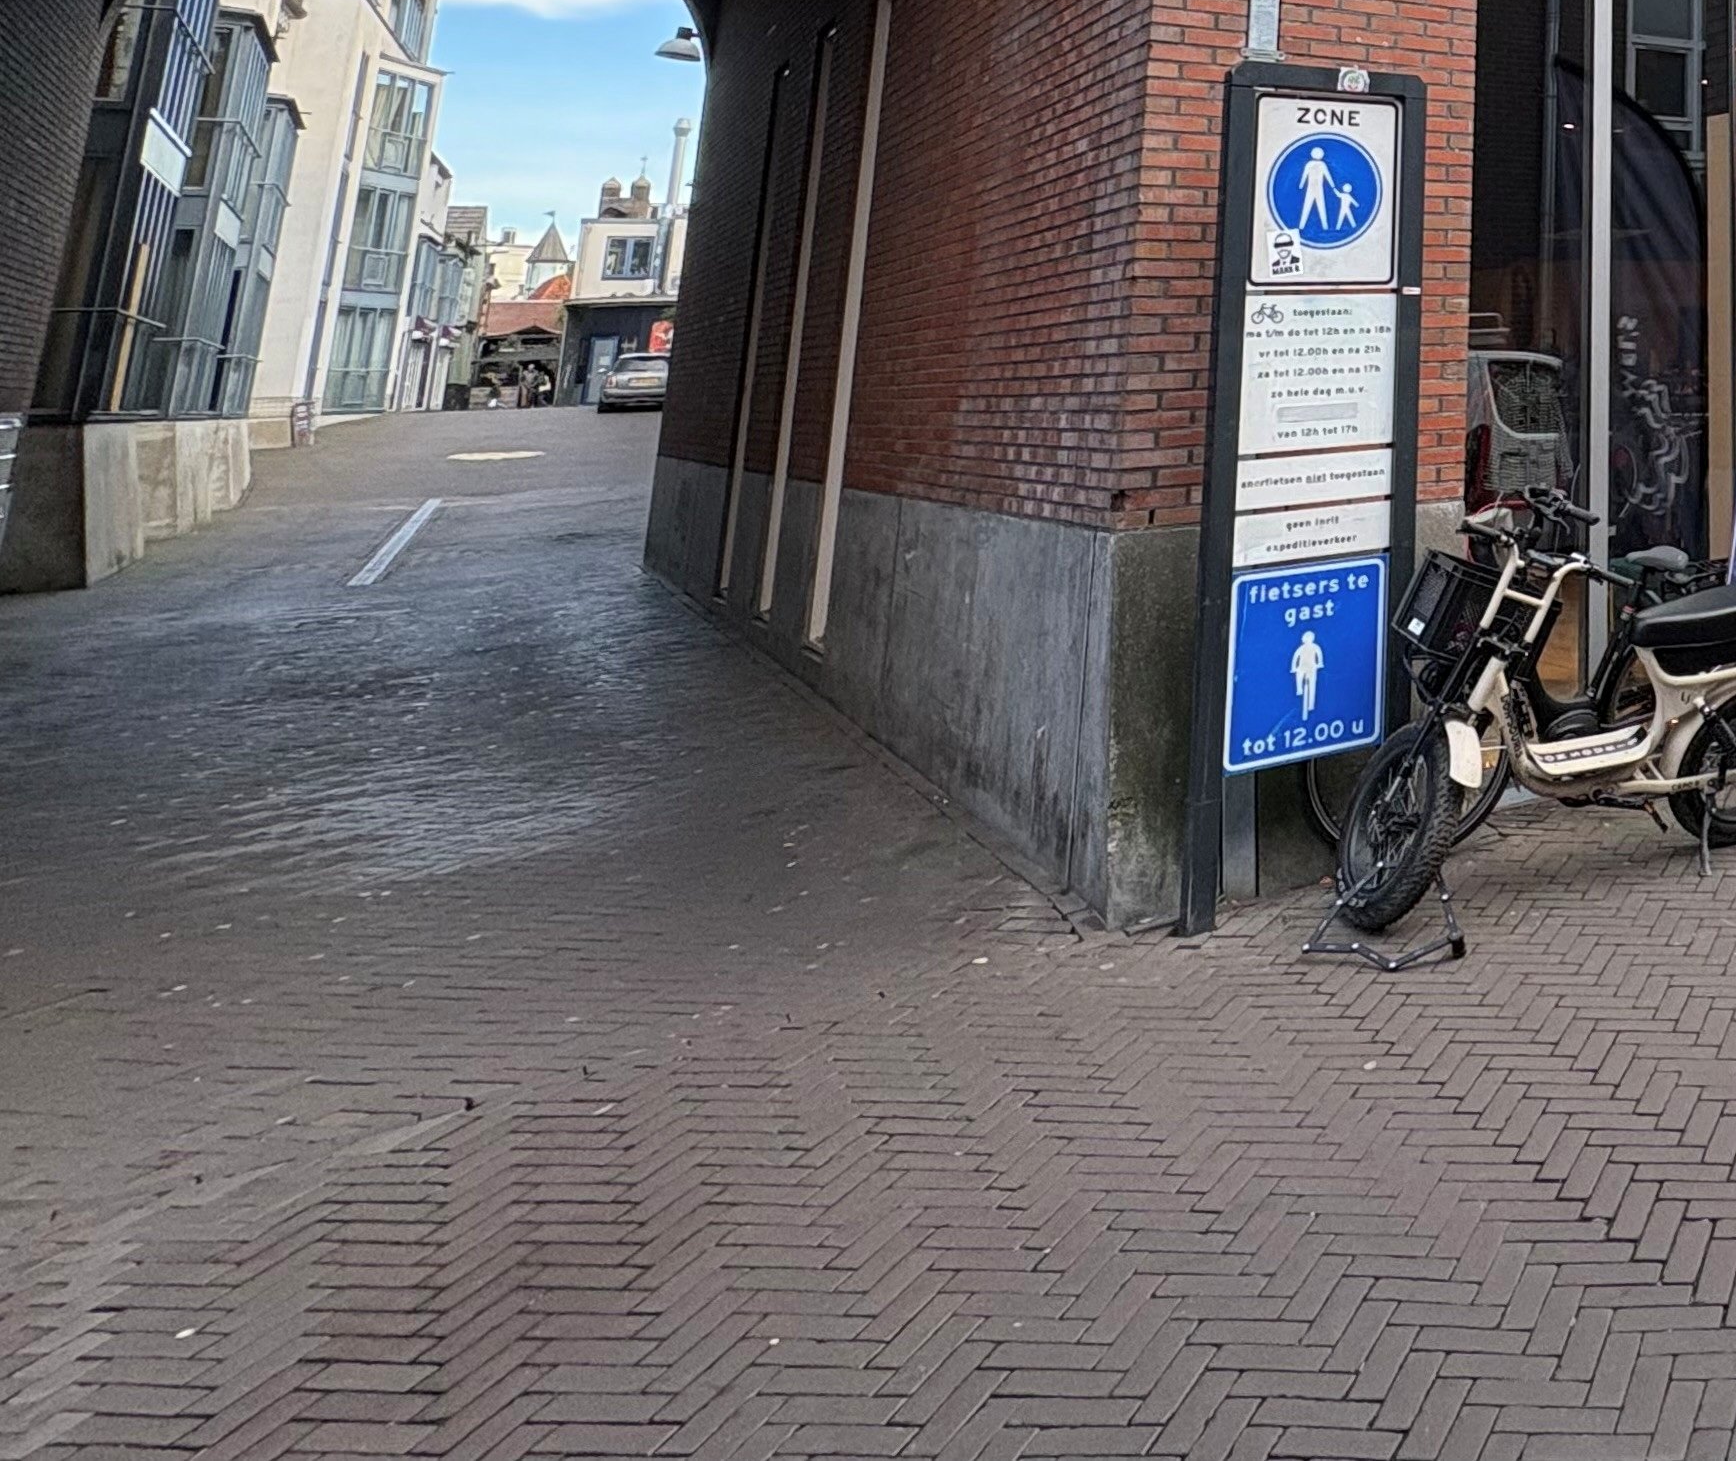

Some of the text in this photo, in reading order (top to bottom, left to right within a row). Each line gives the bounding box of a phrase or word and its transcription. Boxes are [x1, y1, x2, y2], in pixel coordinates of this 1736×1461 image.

[1296, 107, 1360, 126] ZONE
[1265, 329, 1284, 338] t/m
[1288, 328, 1300, 337] do
[1303, 328, 1319, 336] tot
[1322, 327, 1340, 336] 12h
[1274, 349, 1289, 357] tot
[1332, 347, 1344, 355] en
[1274, 369, 1289, 378] tot
[1332, 367, 1345, 375] en
[1313, 387, 1332, 397] dag
[1277, 430, 1298, 439] van
[1323, 426, 1338, 436] tot
[1306, 473, 1327, 483] niet
[1286, 520, 1311, 532] geen
[1249, 573, 1369, 604] fietsers te
[1284, 599, 1335, 627] gast
[1242, 719, 1364, 755] tot 12.00 u
